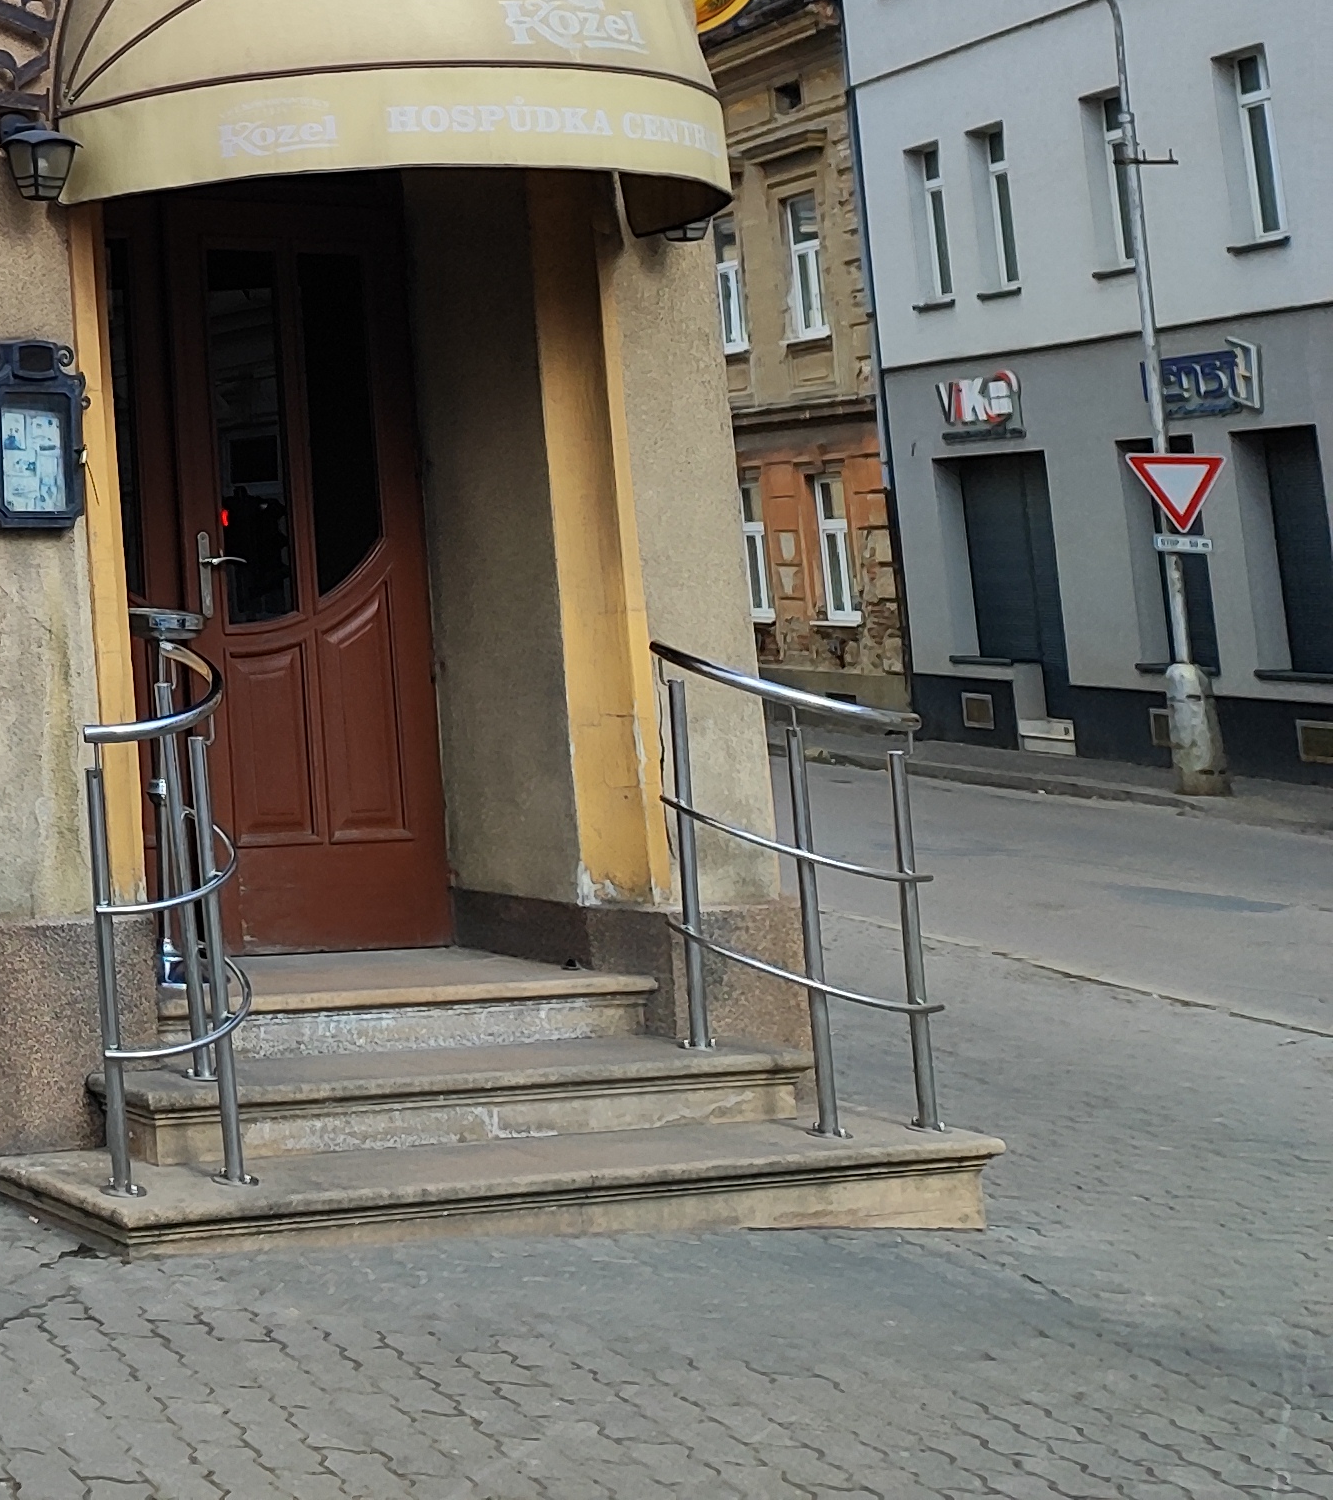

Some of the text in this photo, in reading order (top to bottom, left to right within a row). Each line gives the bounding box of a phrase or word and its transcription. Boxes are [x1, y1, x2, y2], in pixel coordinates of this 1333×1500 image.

[498, 0, 650, 53] Kozel
[218, 114, 338, 158] Kozel
[386, 95, 614, 137] HOSPŮDKA
